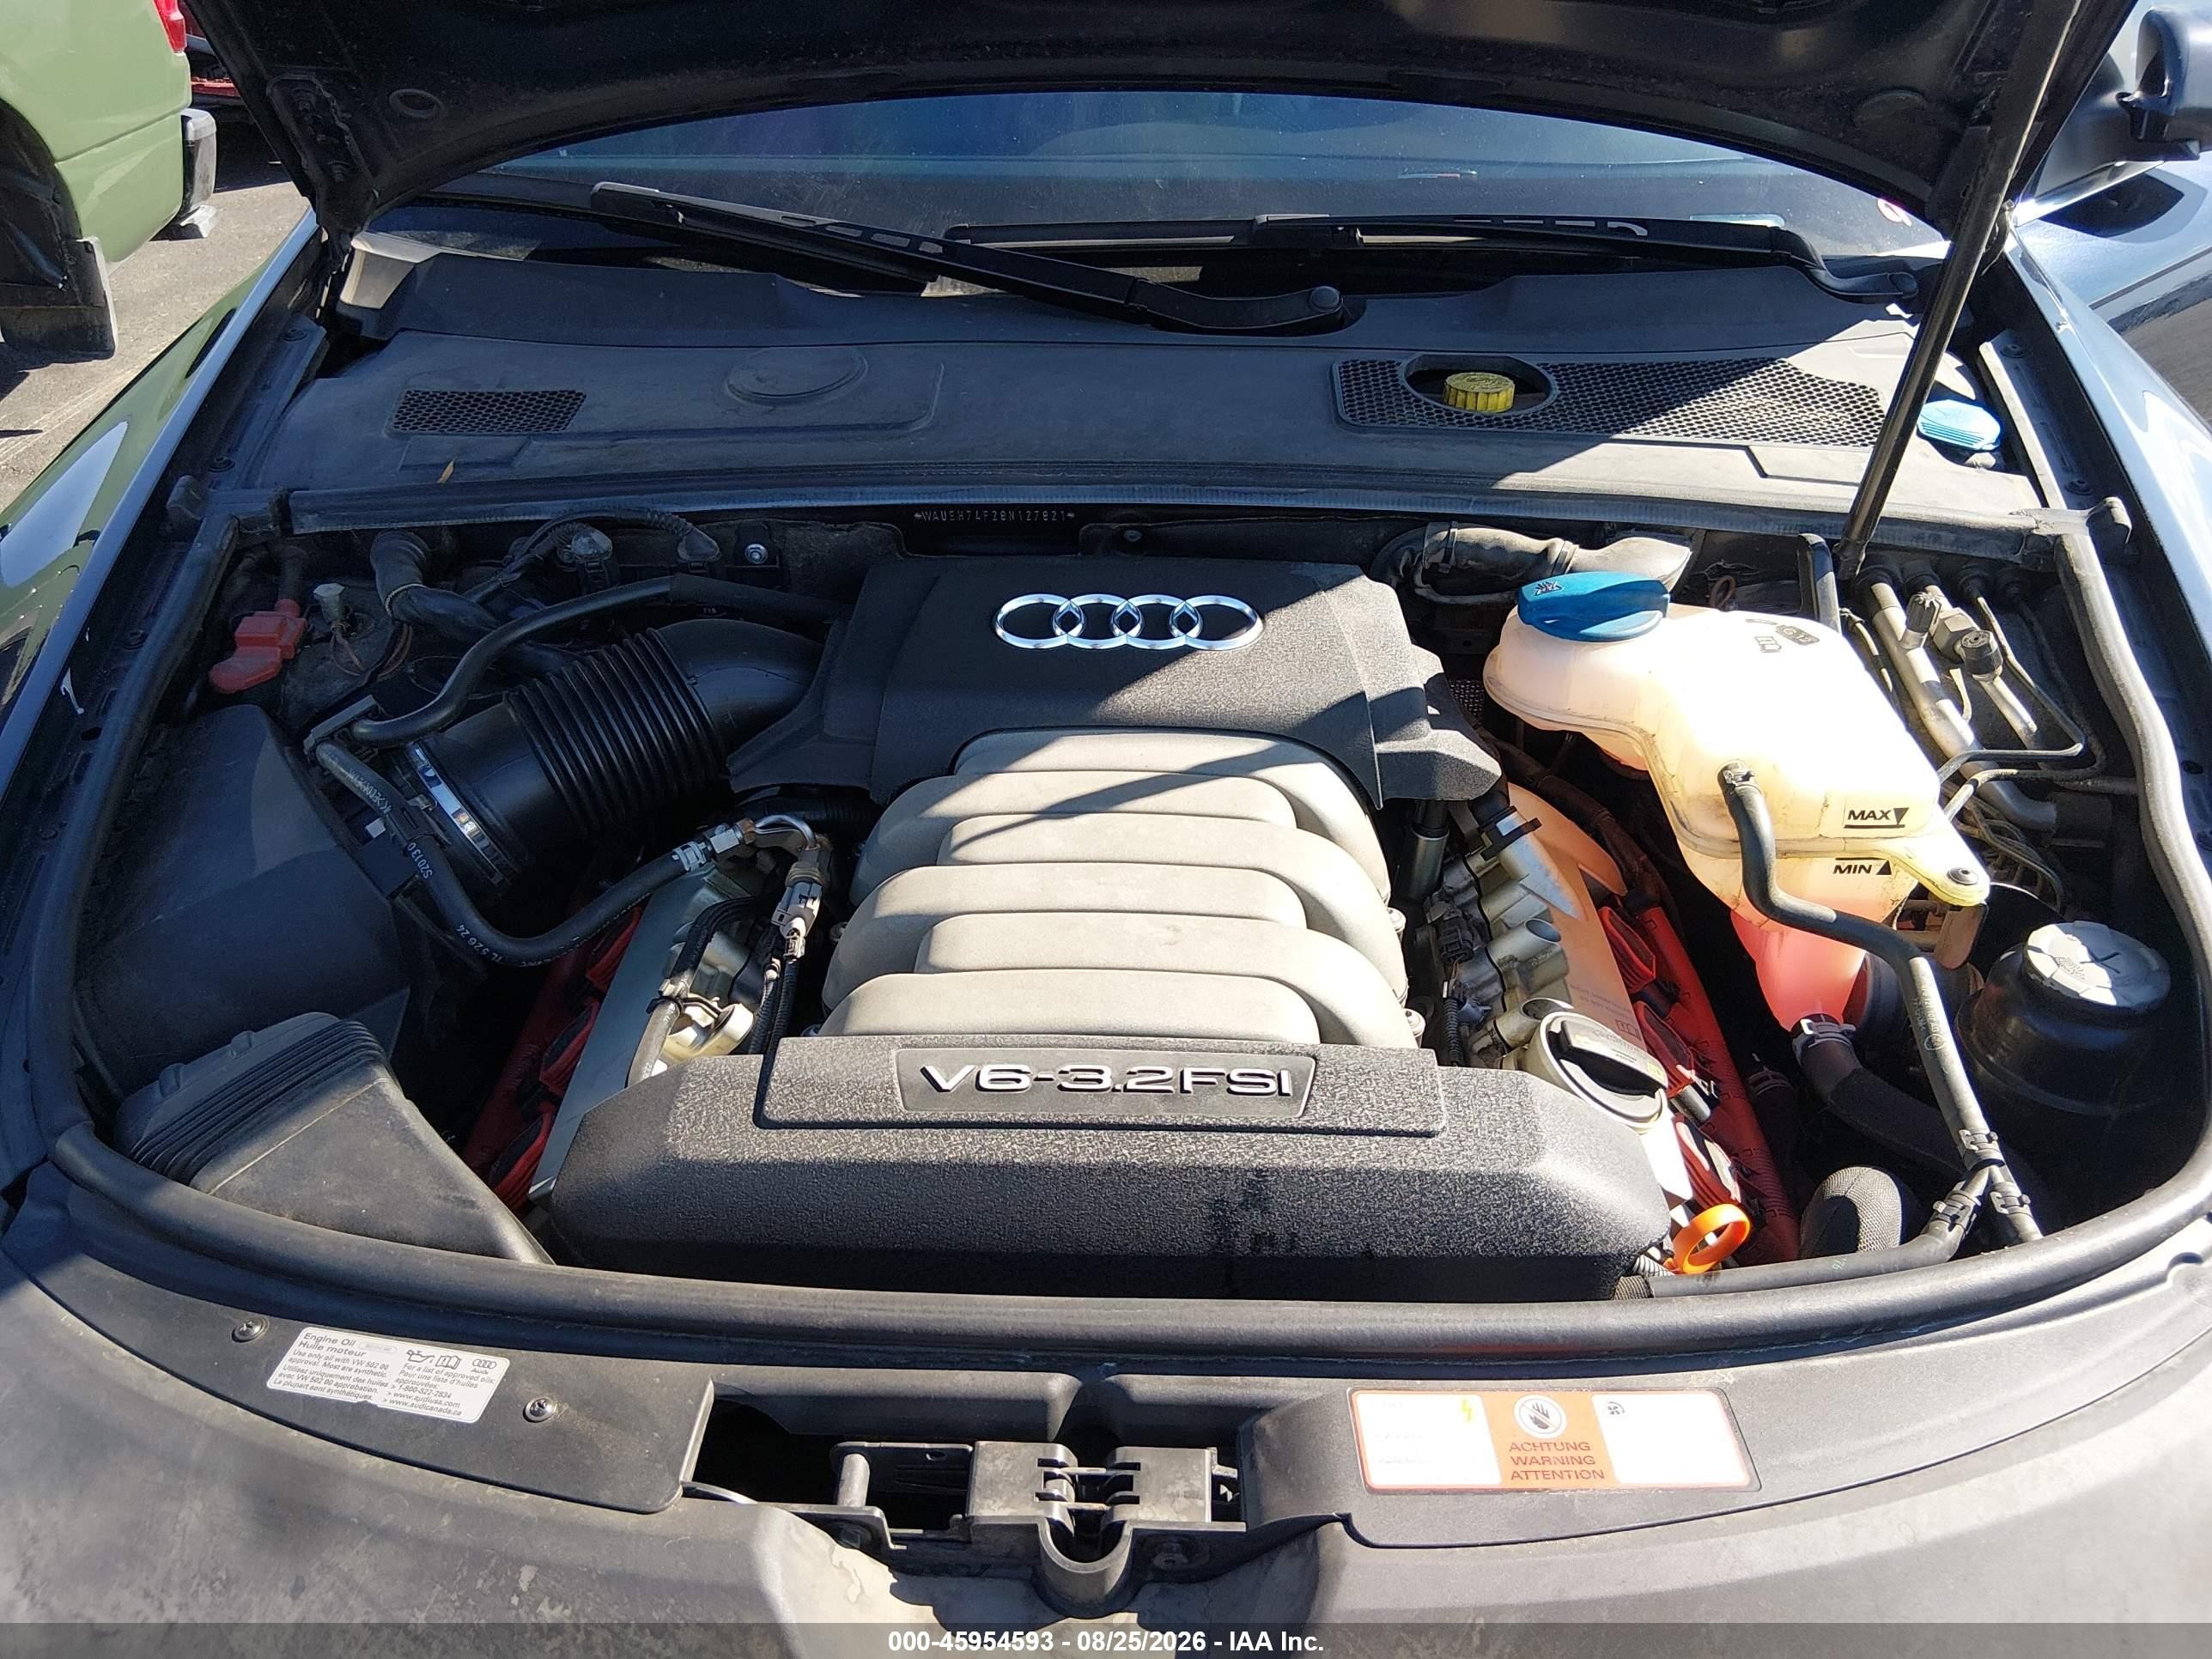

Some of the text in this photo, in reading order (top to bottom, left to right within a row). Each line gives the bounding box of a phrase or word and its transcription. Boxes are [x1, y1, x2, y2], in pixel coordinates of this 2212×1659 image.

[1847, 810, 1892, 821] MAX
[1832, 864, 1873, 874] MIN
[304, 1332, 337, 1344] Engine
[298, 1340, 324, 1350] Huile
[326, 1346, 366, 1357] moteur
[322, 1361, 341, 1370] Most
[309, 1370, 352, 1382] uniquement
[367, 1378, 388, 1387] huiles
[398, 1369, 416, 1377] Pour
[444, 1370, 480, 1381] approved
[283, 1380, 309, 1389] plupart
[334, 1381, 378, 1393] approbation.
[390, 1399, 461, 1415] www.audicanada.ca
[1510, 1442, 1590, 1451] ACHTUNG
[1510, 1455, 1595, 1465] WARNING
[1511, 1469, 1605, 1480] ATTENTION
